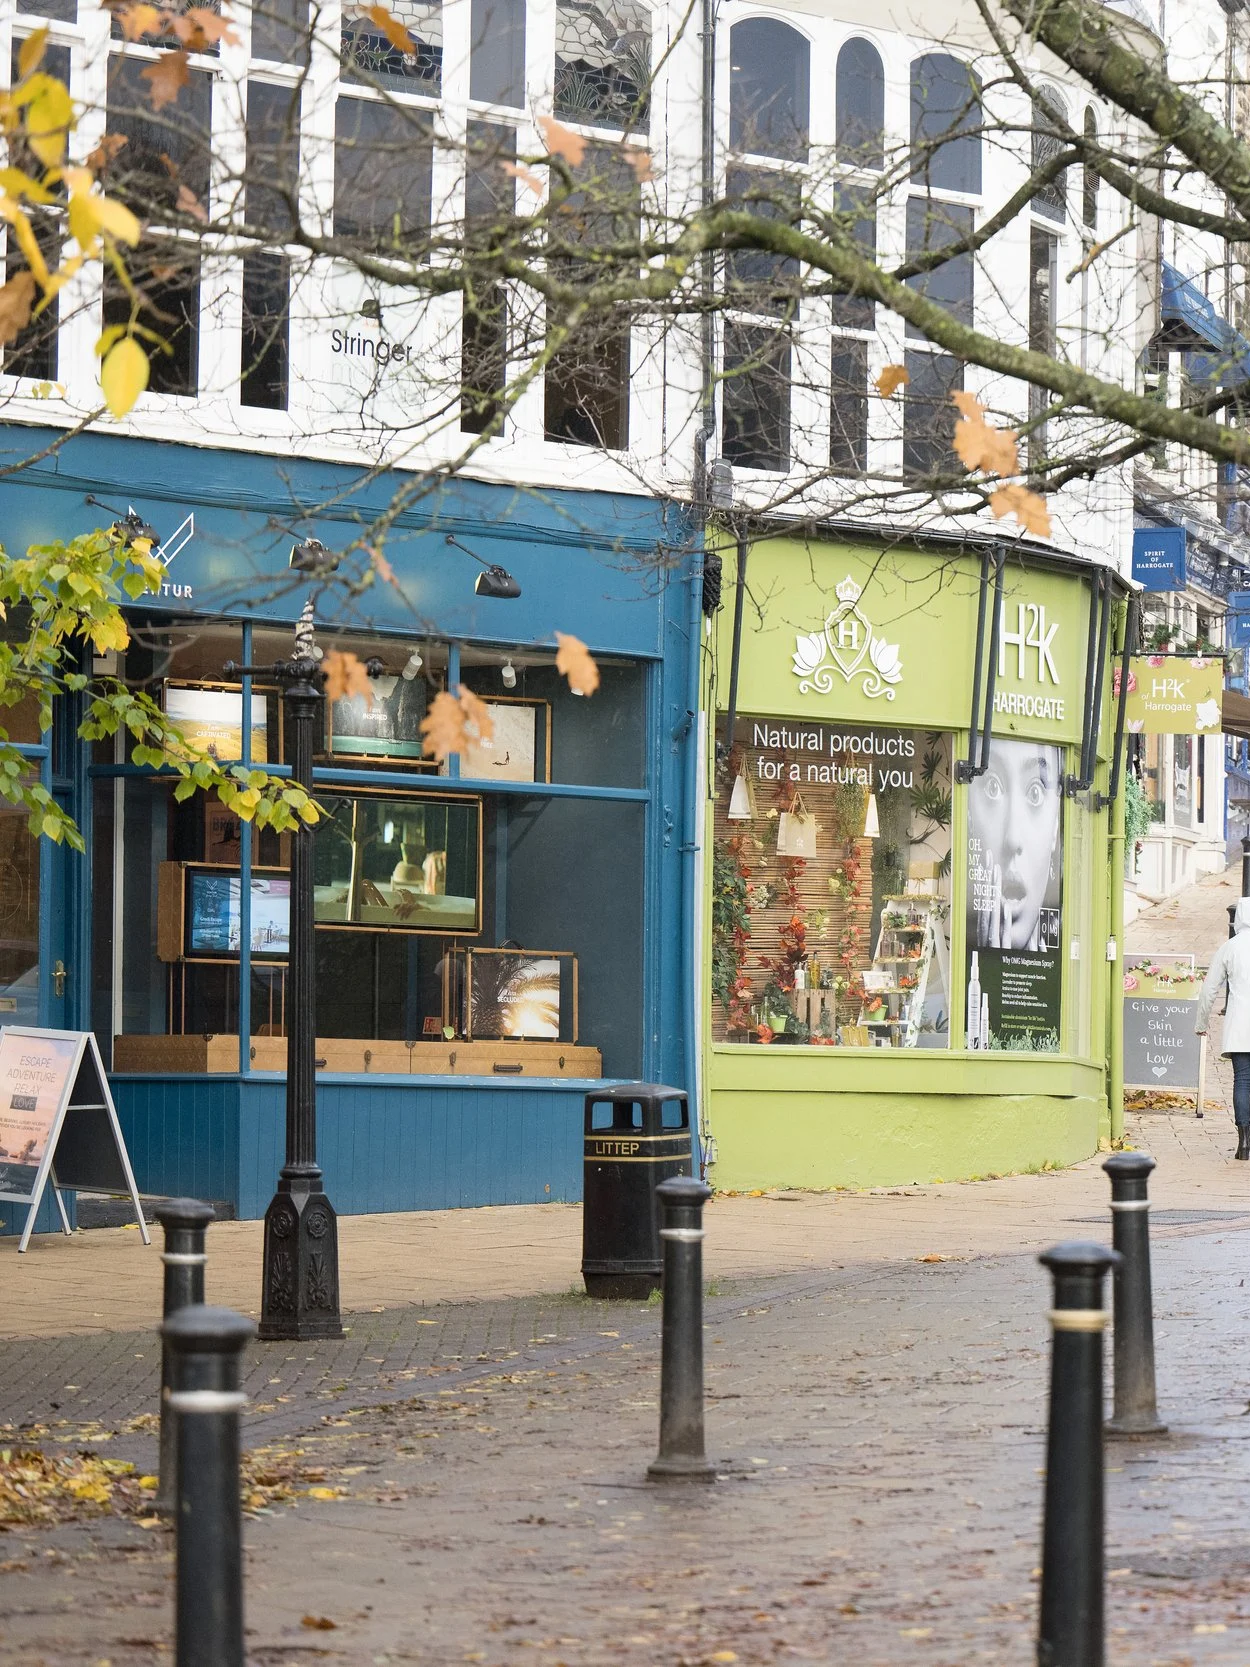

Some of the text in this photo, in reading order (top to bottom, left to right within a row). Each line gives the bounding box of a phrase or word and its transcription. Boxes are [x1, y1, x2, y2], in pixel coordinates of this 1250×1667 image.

[331, 329, 412, 366] Stringer
[836, 620, 860, 650] H
[993, 691, 1065, 720] HARROGATE
[1145, 702, 1192, 713] Harrogate
[753, 723, 915, 757] Natural products
[757, 755, 913, 792] for a natural you
[968, 869, 993, 882] GREAT
[1132, 1001, 1192, 1017] Give your
[1148, 1019, 1173, 1031] Skin
[1140, 1036, 1149, 1045] a
[19, 1055, 52, 1068] ESCAPE
[1146, 1051, 1175, 1064] Love
[7, 1068, 57, 1083] ADVENTURE
[14, 1083, 42, 1095] RELAX
[13, 1096, 35, 1109] LOVE
